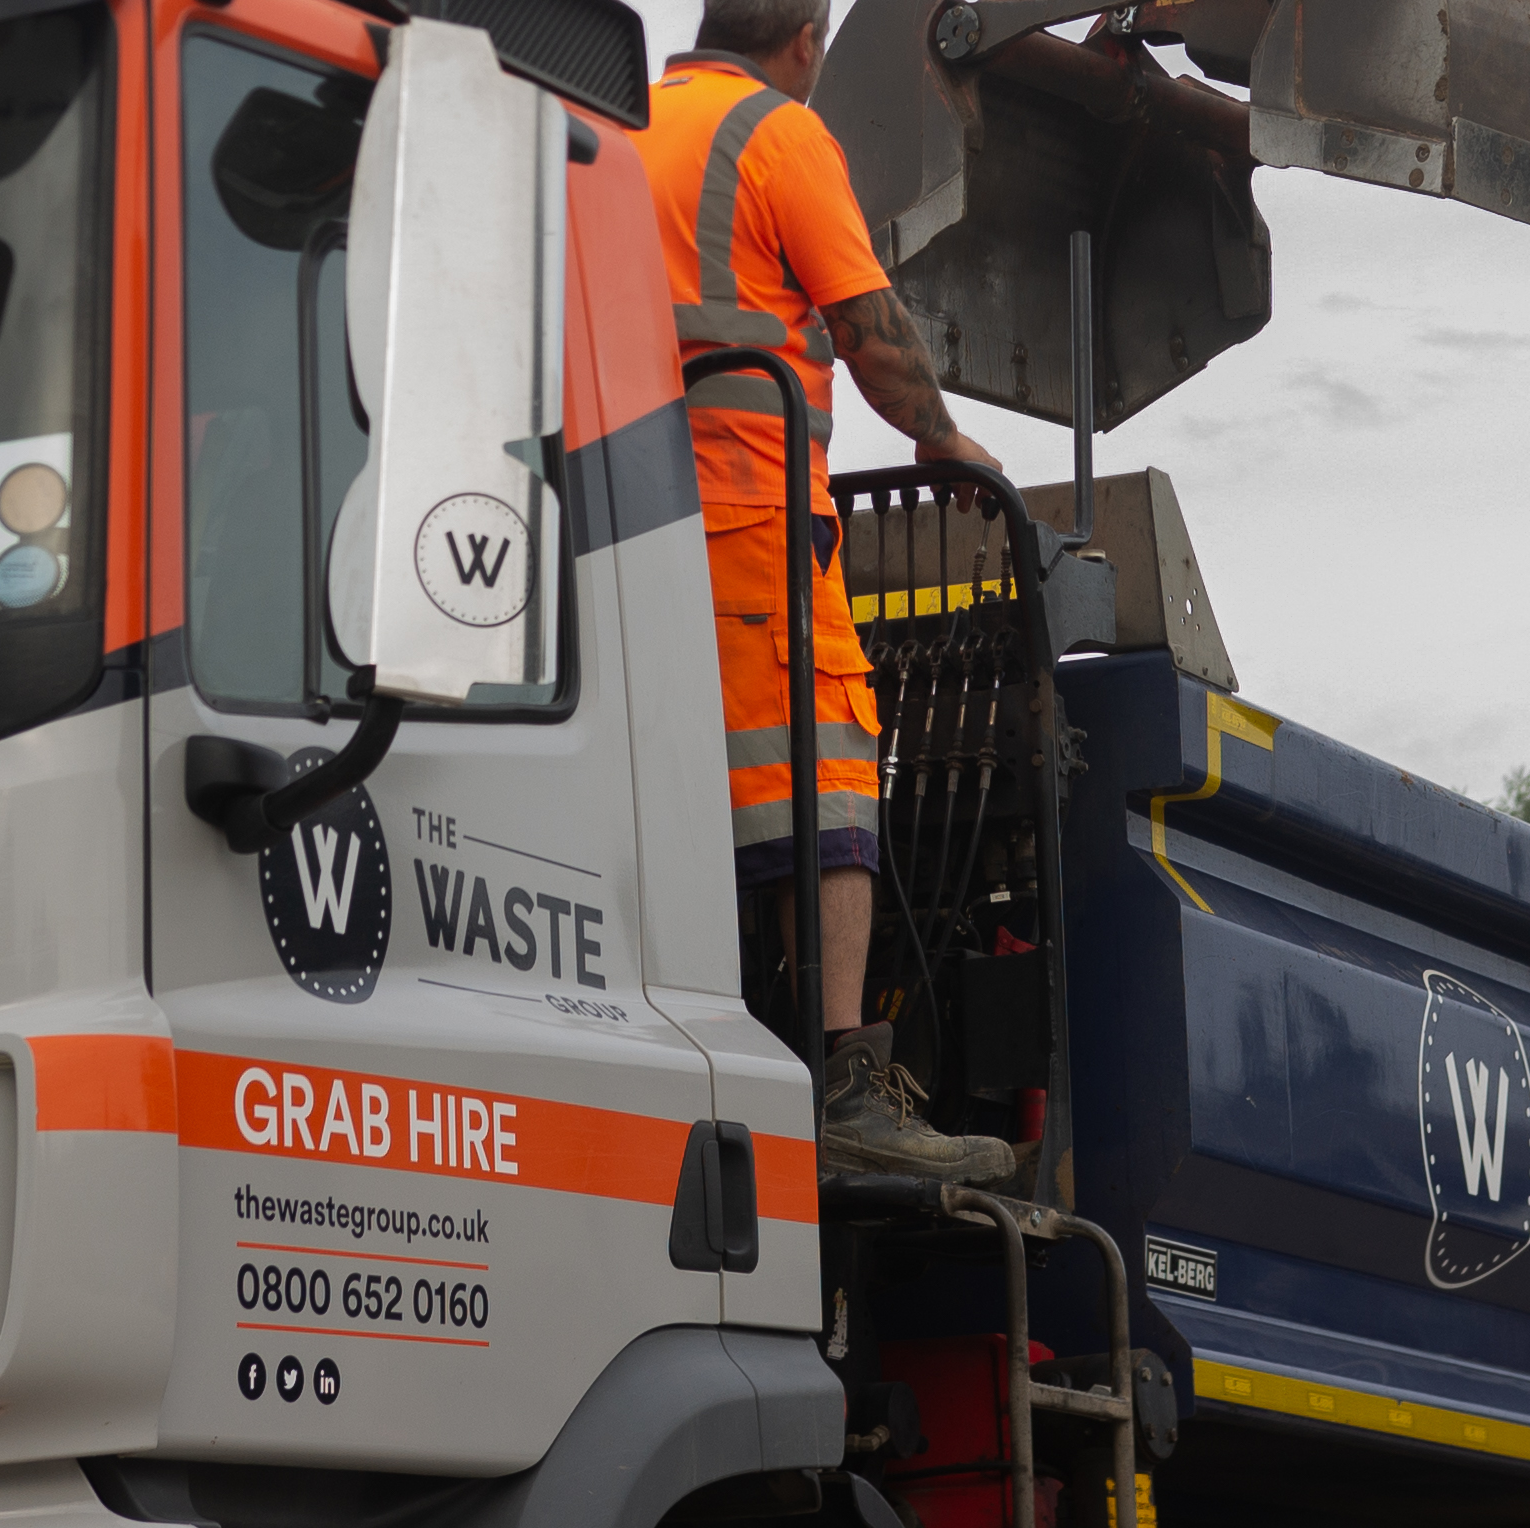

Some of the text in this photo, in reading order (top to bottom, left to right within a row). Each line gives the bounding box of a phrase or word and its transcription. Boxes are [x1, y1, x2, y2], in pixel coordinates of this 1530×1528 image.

[412, 807, 457, 849] THE
[292, 824, 361, 935] W
[414, 858, 606, 990] WASTE
[545, 994, 629, 1023] GROUP
[234, 1067, 519, 1175] GRAB HIRE
[1444, 1051, 1510, 1202] W
[234, 1184, 490, 1244] thewastegroup.co.uk
[237, 1263, 489, 1329] 0800 652 0160
[1147, 1248, 1215, 1291] KEL-BERG
